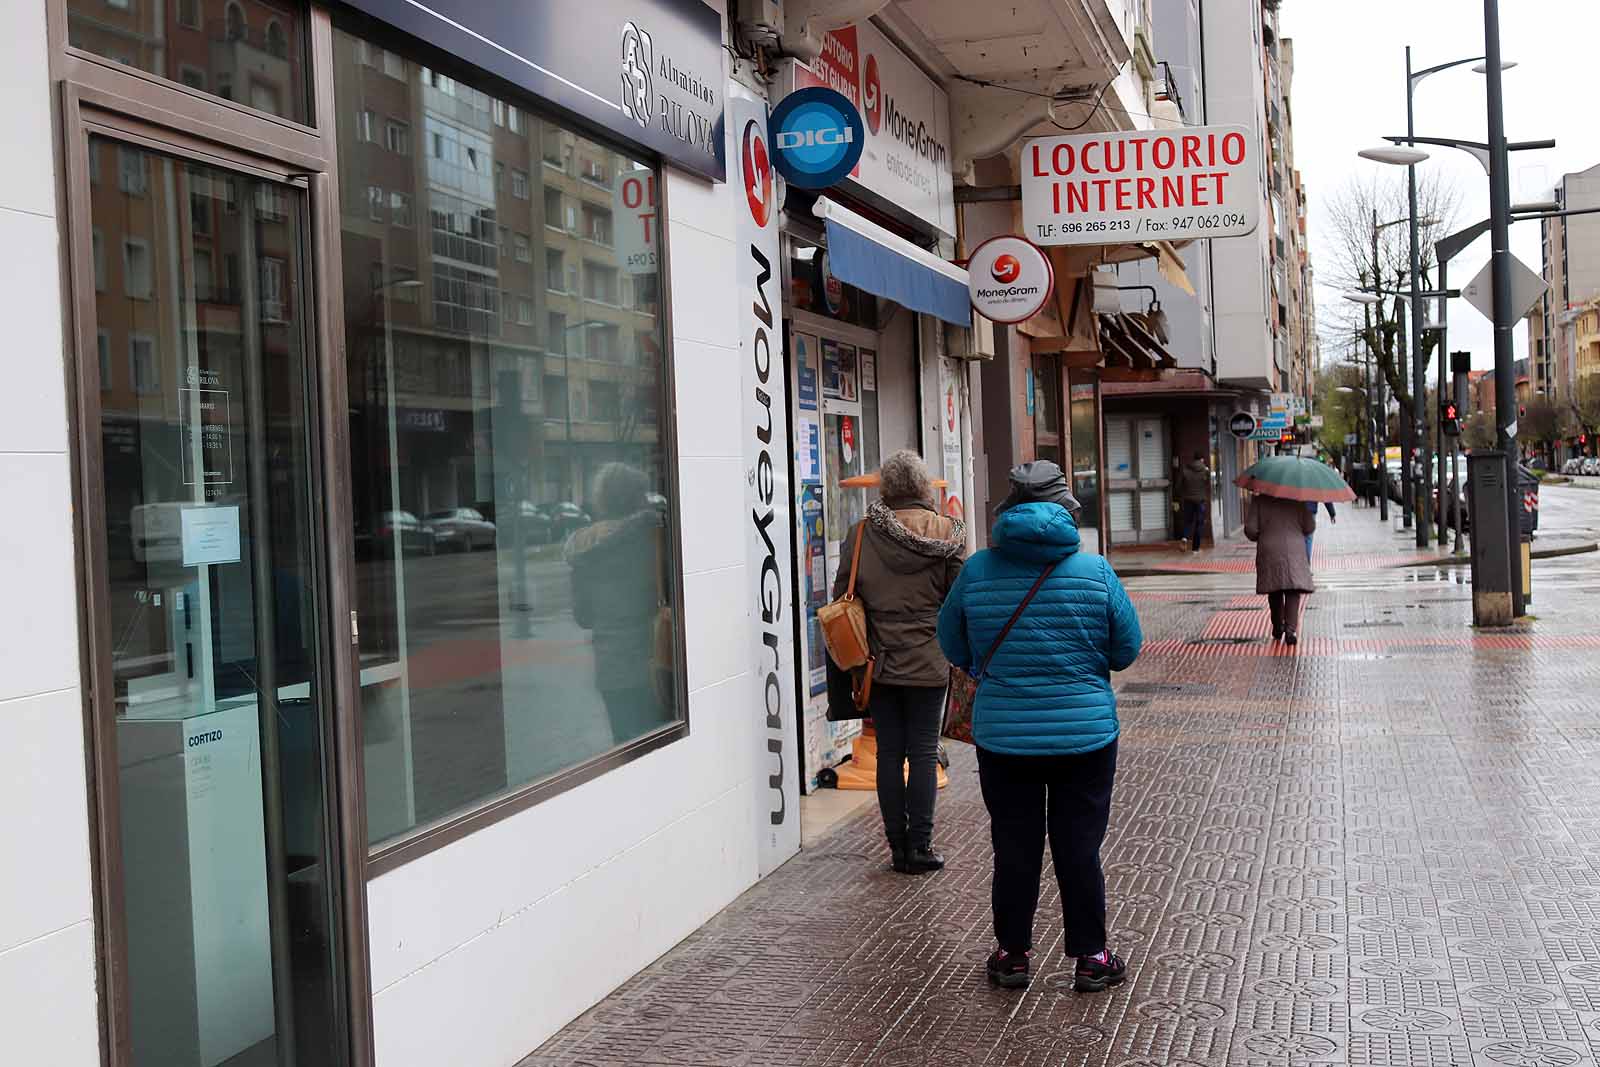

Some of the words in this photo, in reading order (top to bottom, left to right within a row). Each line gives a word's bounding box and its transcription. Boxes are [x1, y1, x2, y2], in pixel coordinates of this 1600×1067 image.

[660, 55, 714, 105] Aluminios
[660, 94, 716, 158] RILOVA
[775, 126, 854, 150] DIGI
[884, 93, 946, 167] MoneyGram
[1032, 132, 1246, 177] LOCUTORIO
[1053, 172, 1229, 214] INTERNET
[1037, 224, 1057, 238] TLF:
[1062, 222, 1083, 233] 696
[1085, 220, 1107, 232] 265
[1109, 219, 1131, 231] 213
[1146, 218, 1169, 232] Fax:
[1172, 216, 1194, 230] 947
[1197, 214, 1220, 229] 062
[1223, 213, 1246, 227] 094
[976, 286, 1038, 298] MoneyGram
[749, 242, 785, 825] MoneyGram
[188, 729, 223, 748] CORTIZO
